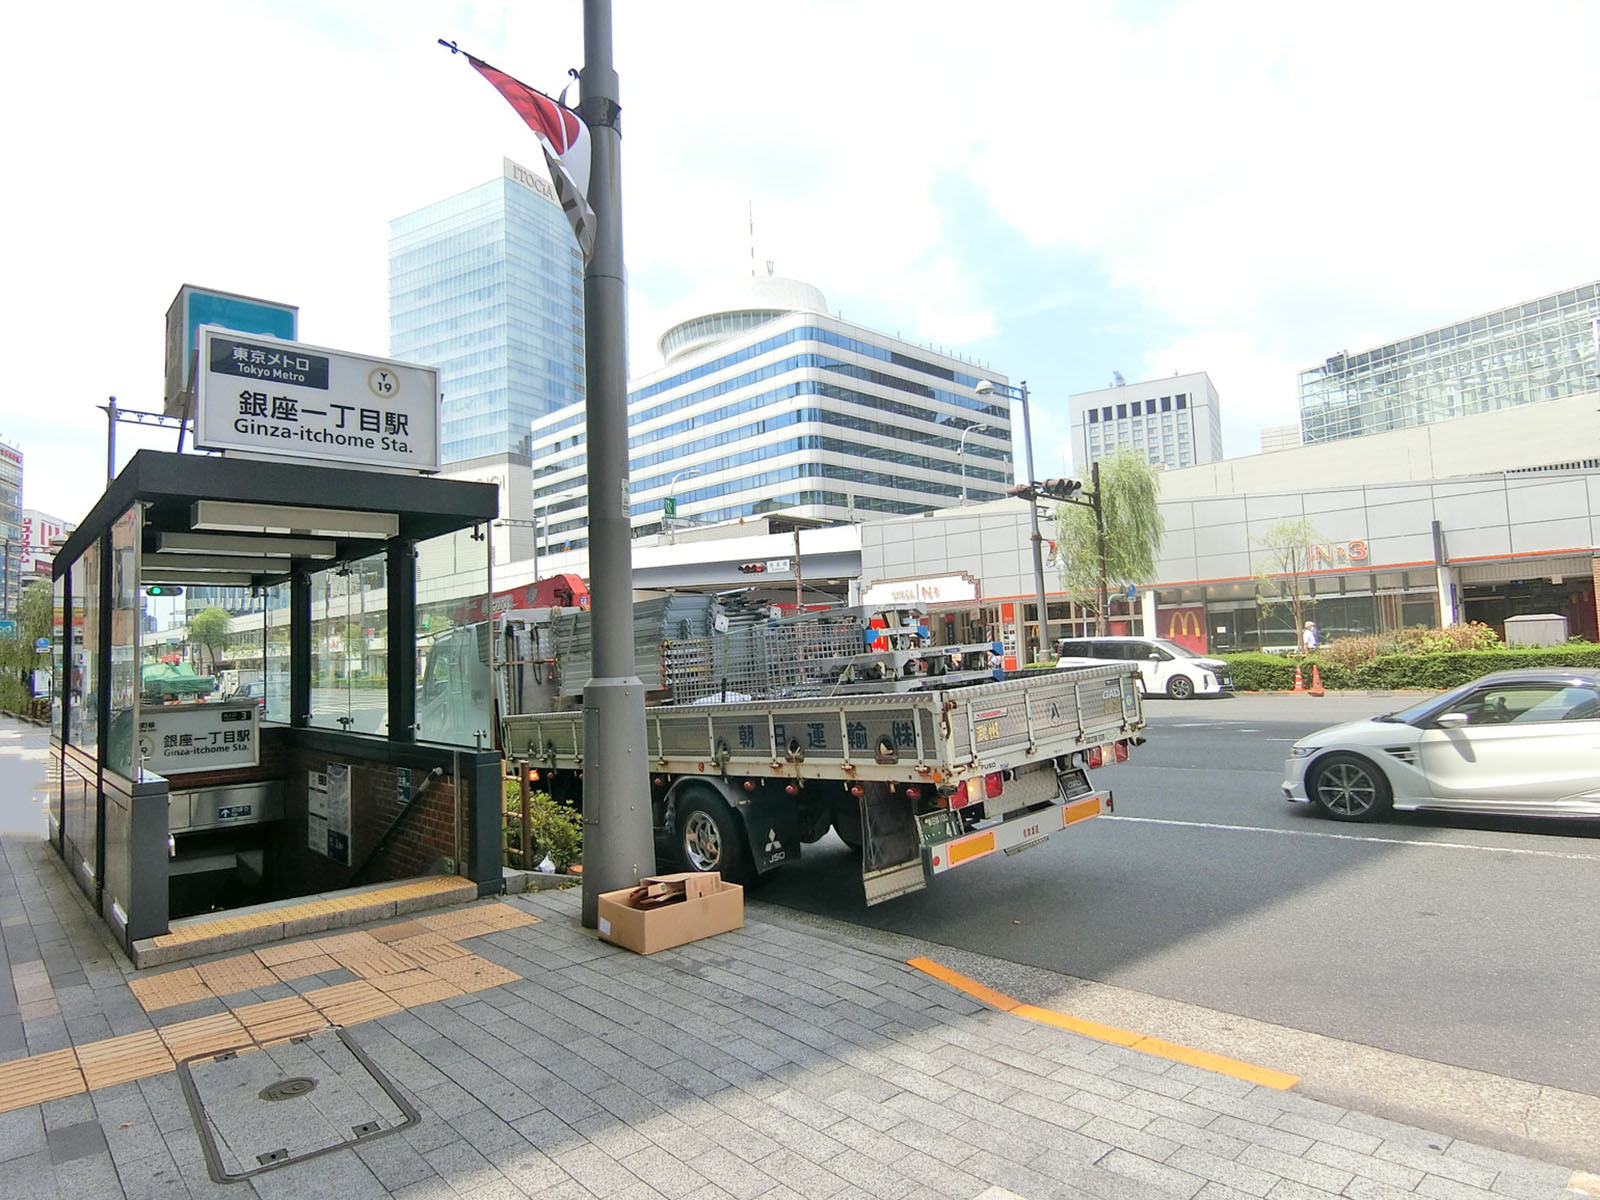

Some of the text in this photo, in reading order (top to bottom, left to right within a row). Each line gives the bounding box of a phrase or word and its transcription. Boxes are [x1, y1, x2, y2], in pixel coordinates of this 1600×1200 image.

[232, 346, 309, 371] 東京メトロ
[237, 362, 305, 382] Tokyo Metro
[380, 373, 388, 382] Y
[377, 382, 392, 393] 19
[239, 389, 409, 437] 銀座一丁目駅
[234, 418, 413, 454] Ginza-itchome Sta.
[240, 711, 248, 721] 3
[163, 729, 250, 748] 銀座一丁目駅
[164, 743, 249, 757] Ginza-itchome Sta.
